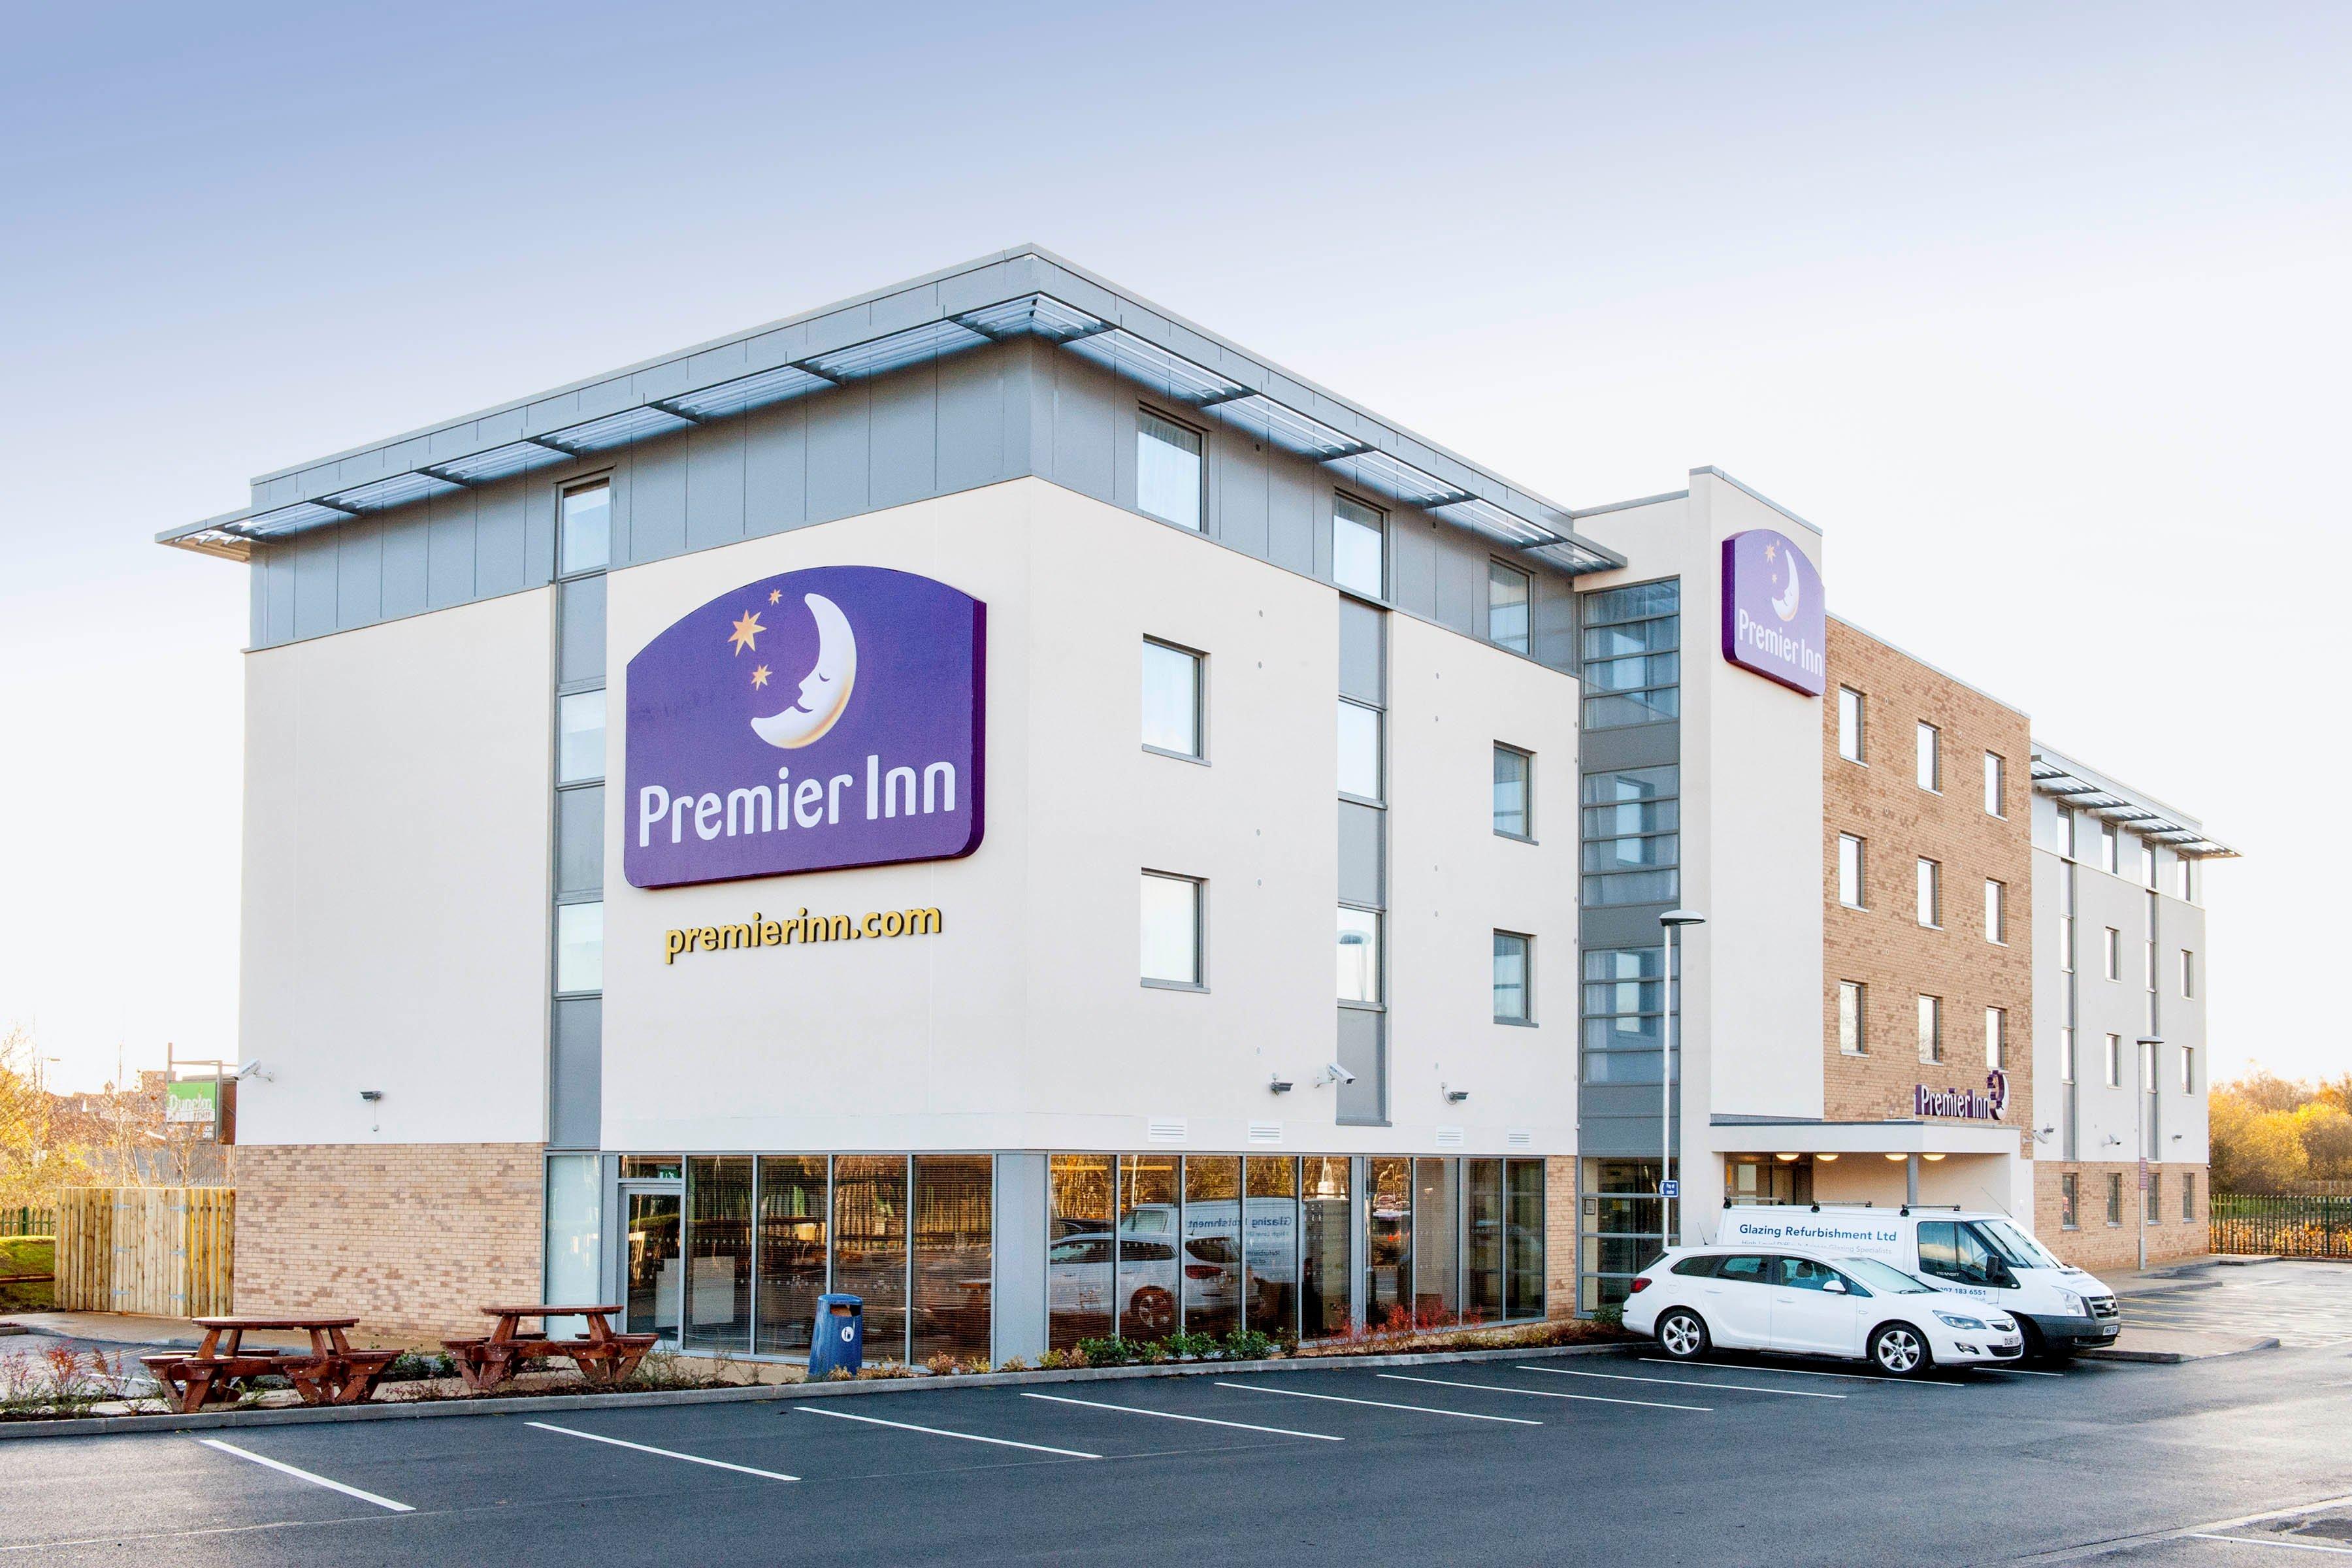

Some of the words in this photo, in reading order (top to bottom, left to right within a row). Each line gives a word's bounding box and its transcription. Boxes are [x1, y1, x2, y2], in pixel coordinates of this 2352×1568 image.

[1739, 608, 1798, 664] Premier
[1801, 638, 1823, 677] Inn
[639, 766, 852, 847] Premier
[866, 755, 955, 820] Inn
[664, 906, 941, 965] premierinn.com
[1916, 1085, 1970, 1117] Premier
[1970, 1089, 1989, 1119] Inn
[1739, 1224, 1781, 1238] Glazing
[1785, 1226, 1872, 1241] Refurbishment
[1876, 1230, 1897, 1241] Ltd
